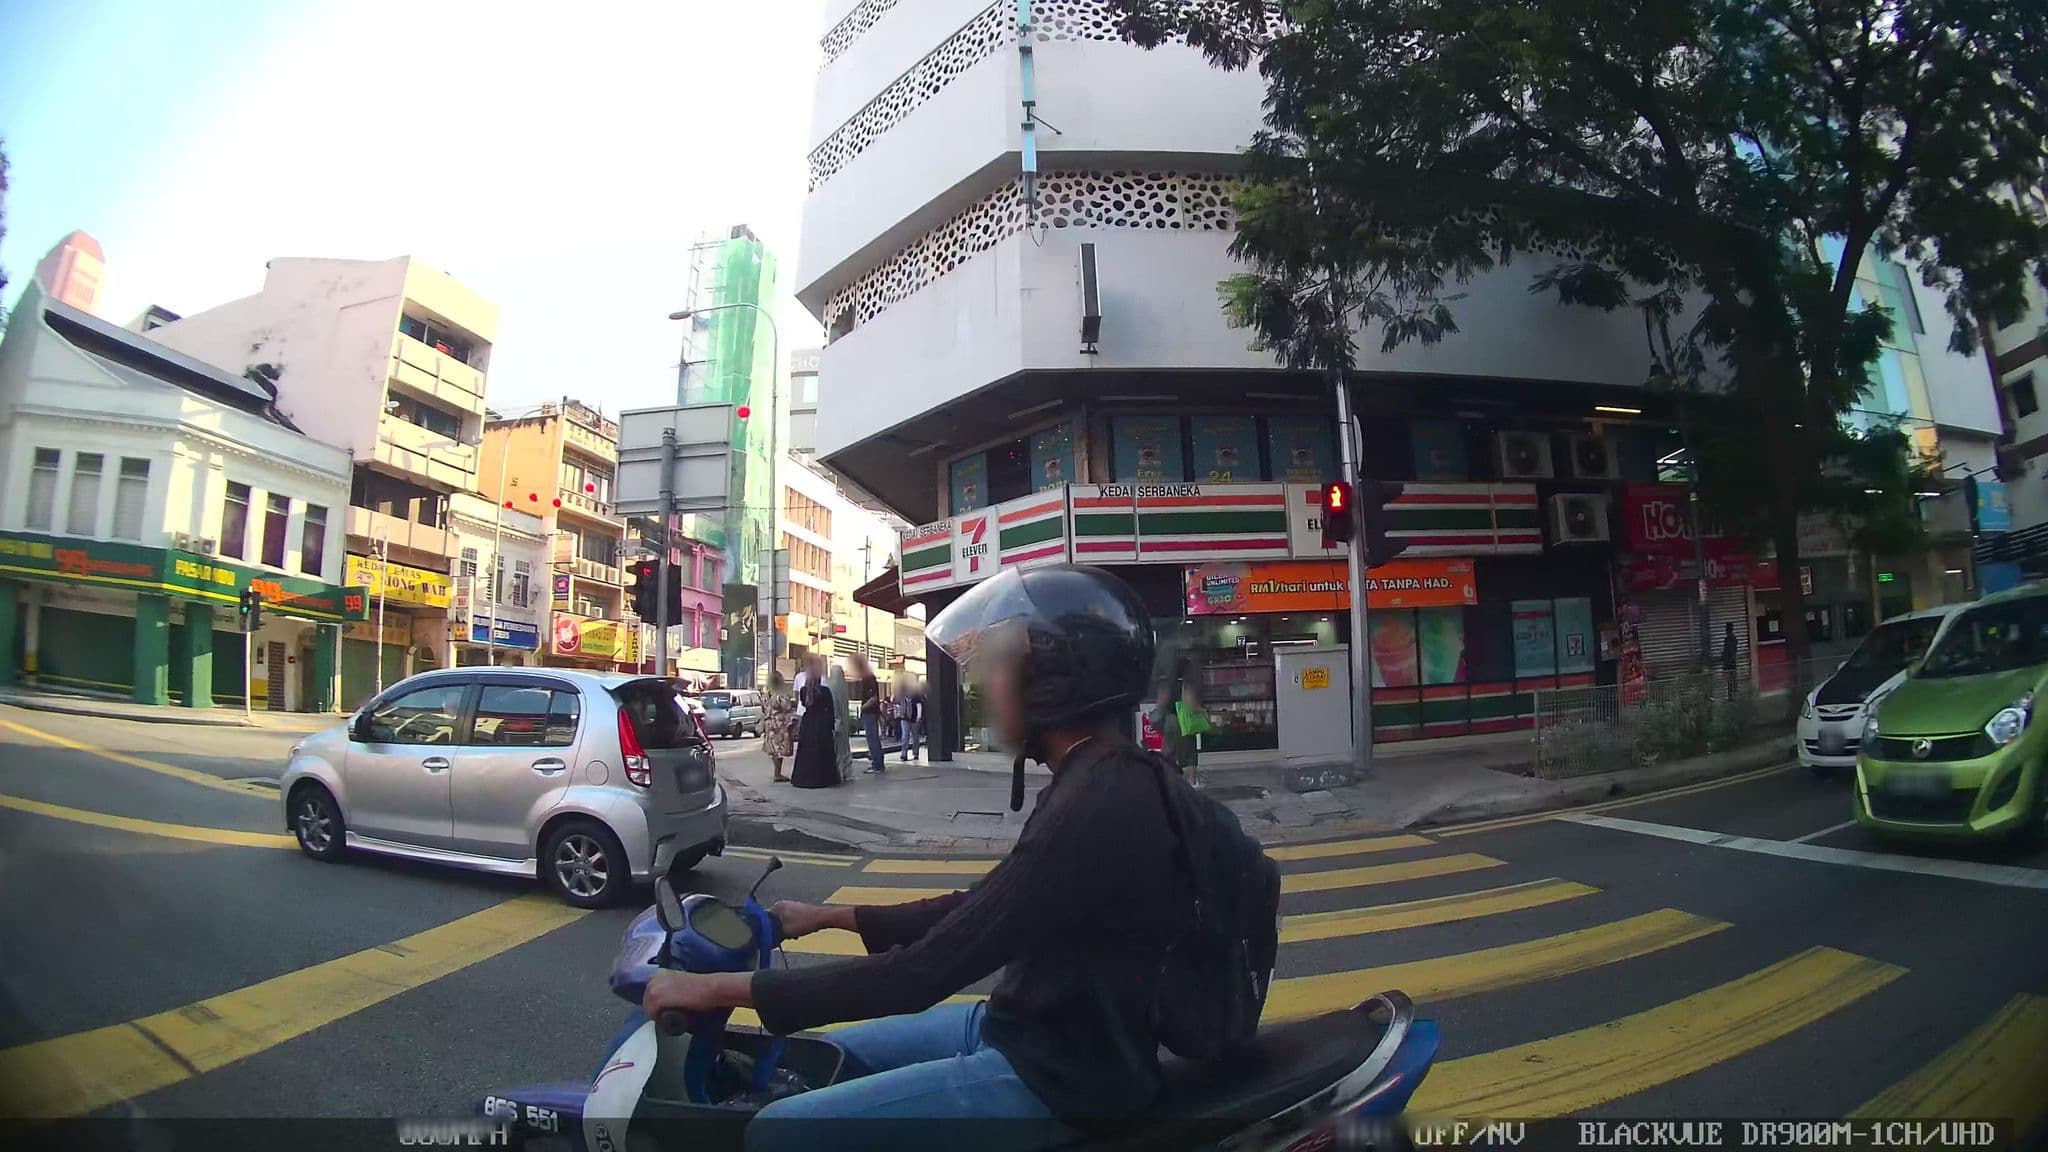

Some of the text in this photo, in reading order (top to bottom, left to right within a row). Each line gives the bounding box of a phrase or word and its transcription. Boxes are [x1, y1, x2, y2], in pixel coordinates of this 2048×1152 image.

[1100, 485, 1200, 497] KEDAI SERBANEKA
[1309, 580, 1344, 591] untuk
[1381, 578, 1420, 590] TANPA
[526, 1105, 559, 1133] 551
